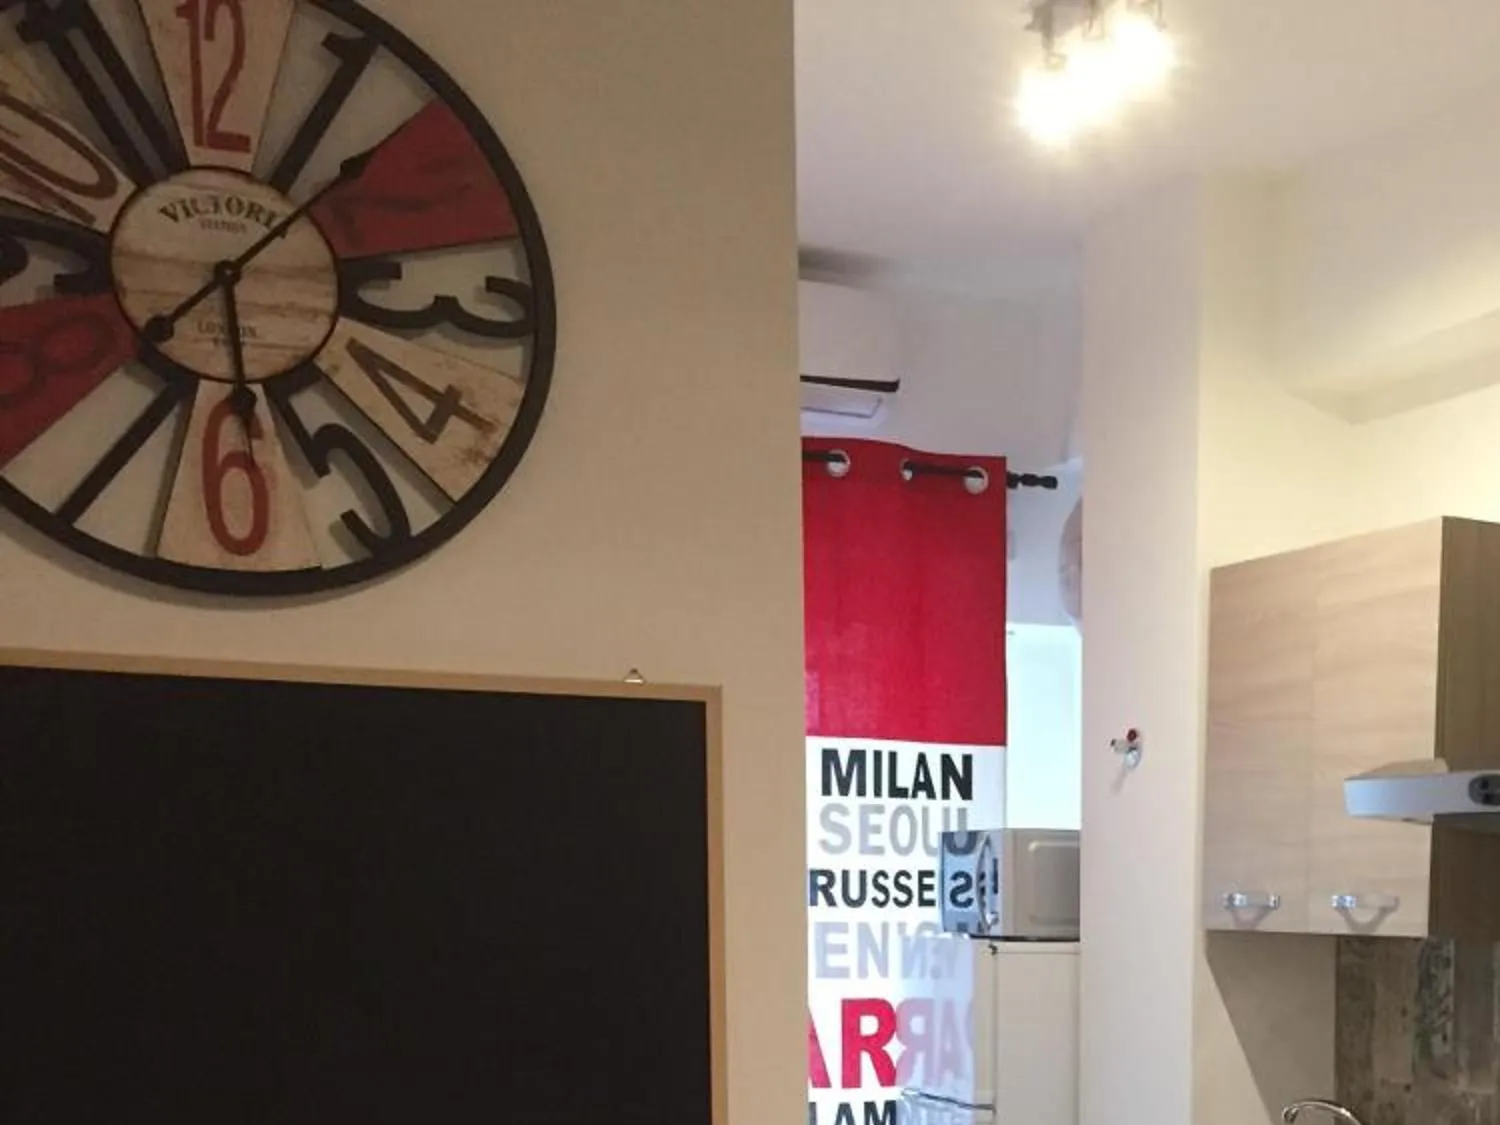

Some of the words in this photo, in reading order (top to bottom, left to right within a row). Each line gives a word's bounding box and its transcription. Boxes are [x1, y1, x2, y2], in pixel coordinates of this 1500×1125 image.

[176, 0, 251, 152] 12
[273, 33, 382, 190] 1
[159, 195, 288, 238] VICTORI
[341, 260, 536, 338] 3
[345, 337, 498, 445] 4
[201, 396, 269, 556] 6
[265, 370, 411, 550] 5
[820, 747, 974, 801] MILAN
[809, 868, 936, 909] RUSSE
